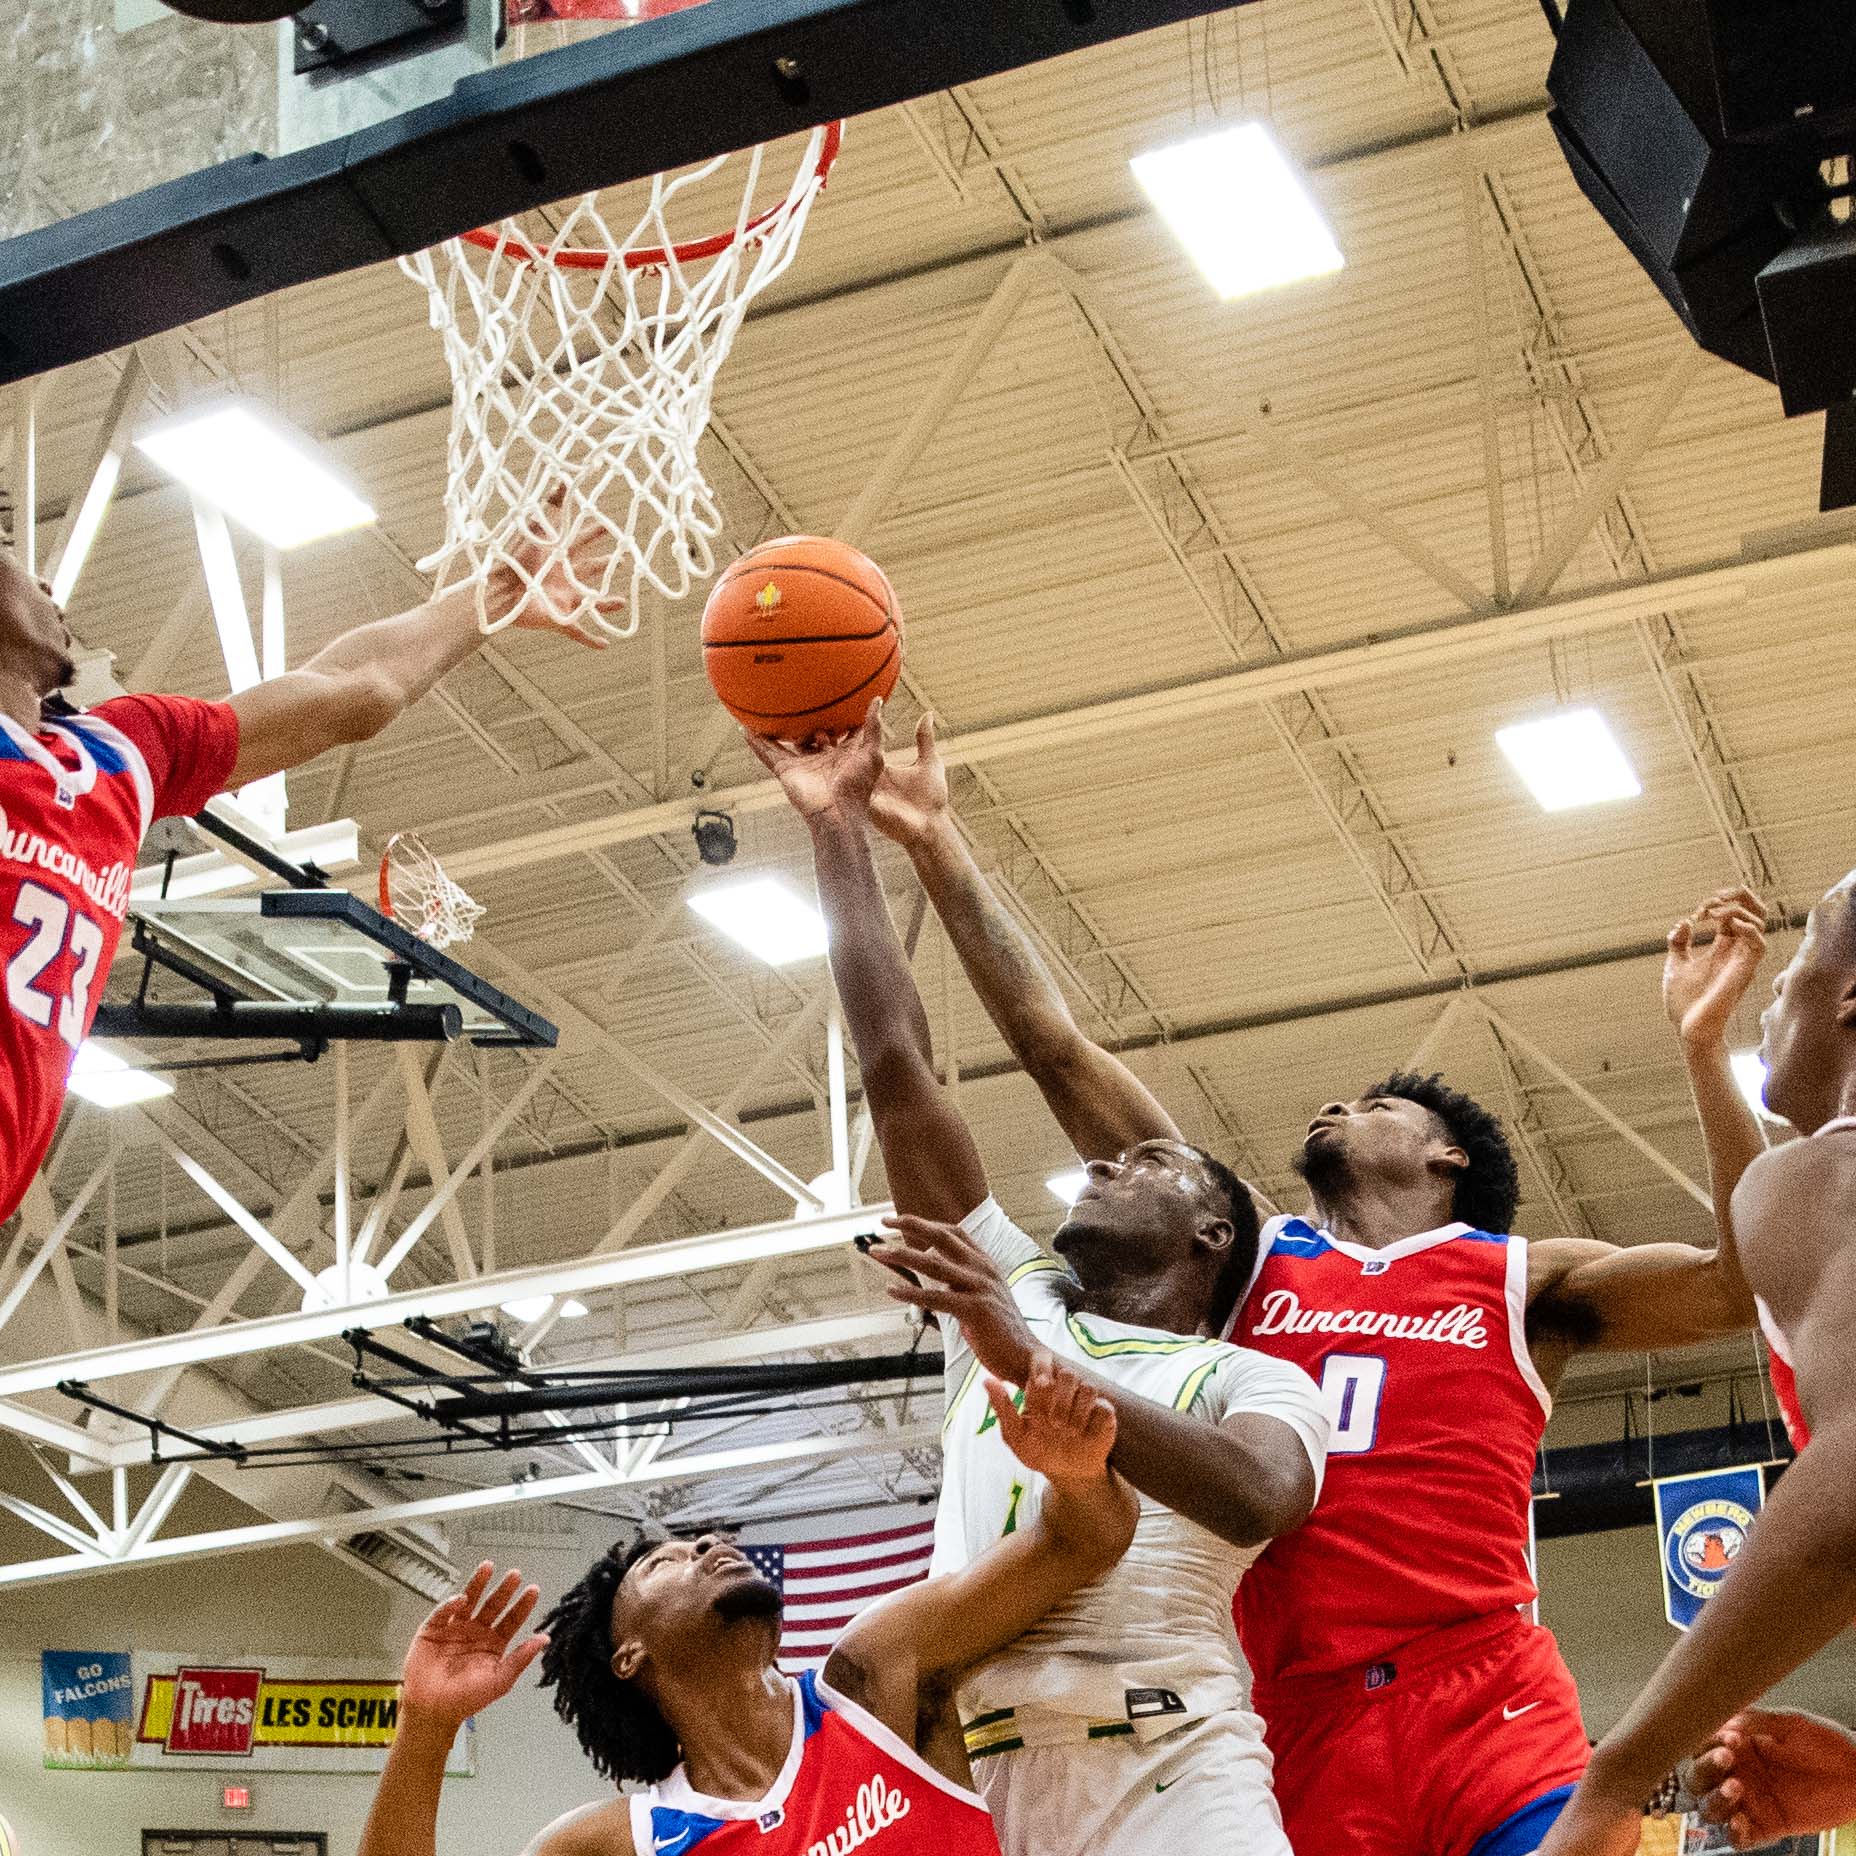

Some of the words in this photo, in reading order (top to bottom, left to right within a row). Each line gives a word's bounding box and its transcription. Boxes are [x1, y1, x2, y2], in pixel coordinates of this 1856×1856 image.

[6, 878, 105, 1052] 23
[1251, 1288, 1489, 1349] Duncanville
[1674, 1503, 1750, 1537] NEWBERG
[76, 1663, 103, 1681] GO
[54, 1674, 134, 1705] FALCONS
[180, 1680, 253, 1732] Tires
[262, 1697, 311, 1728] LES
